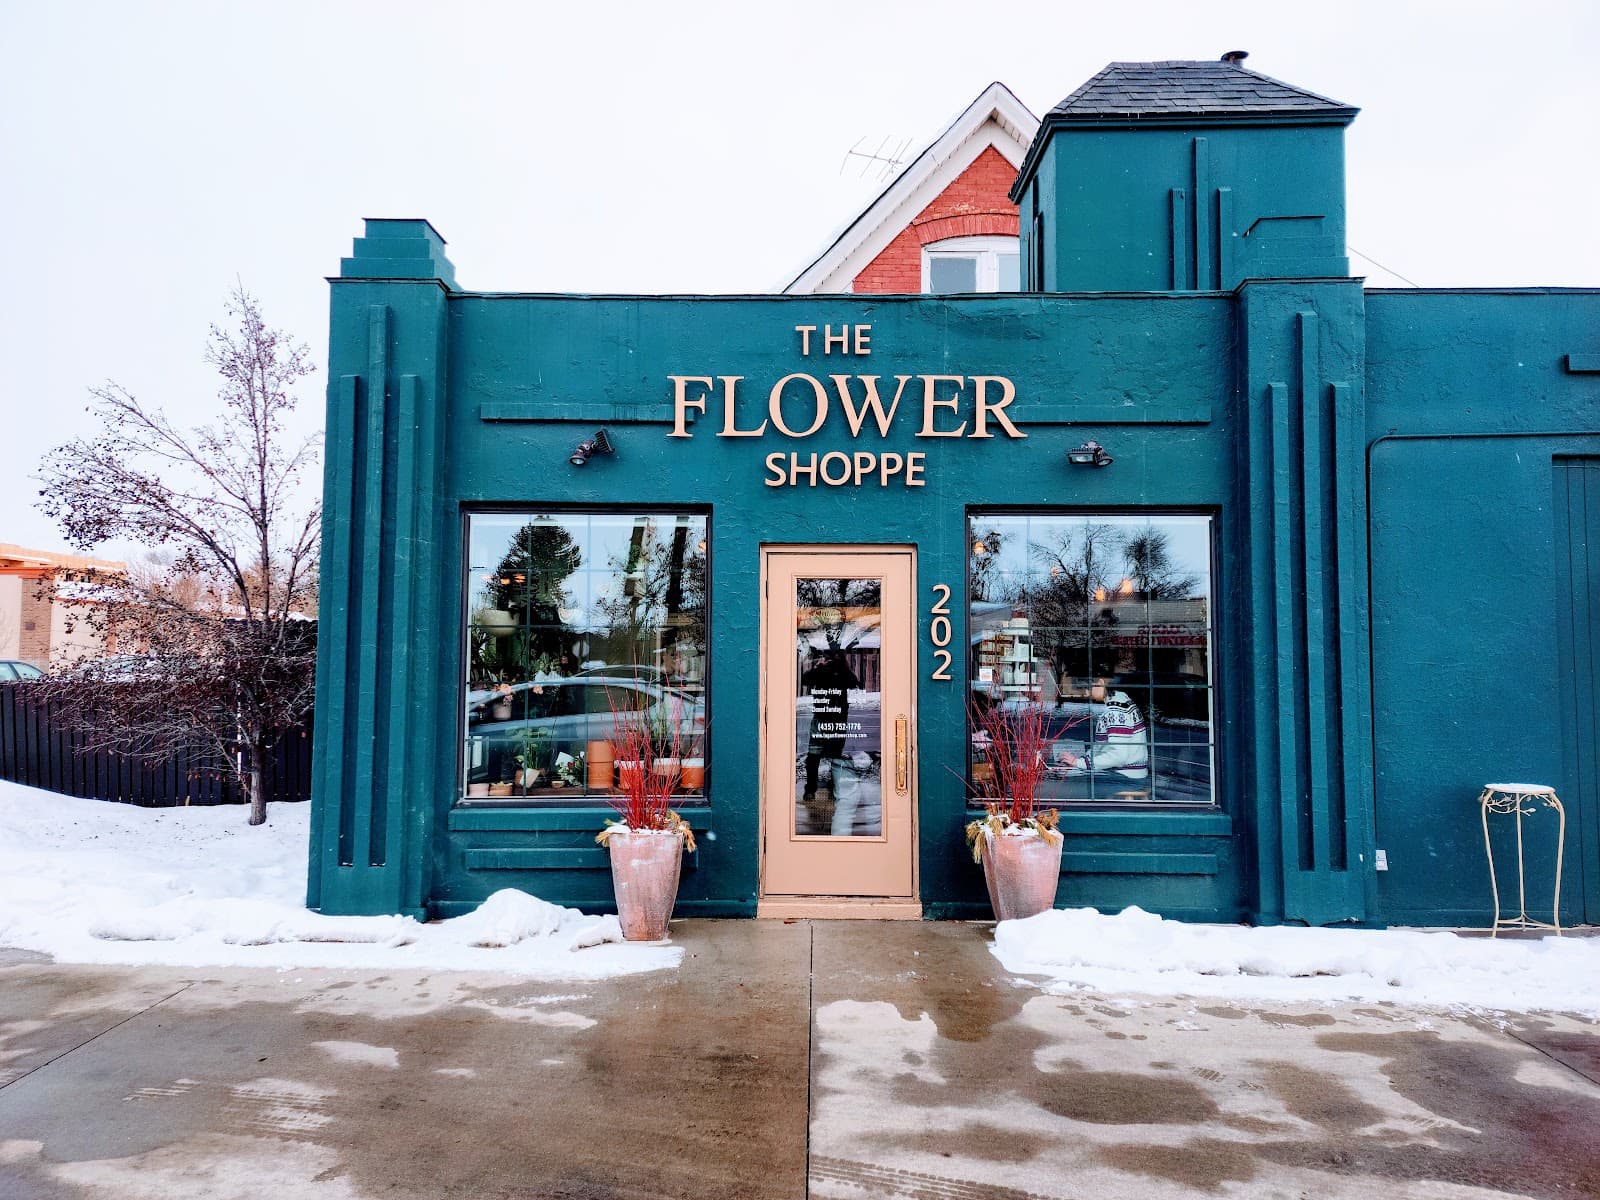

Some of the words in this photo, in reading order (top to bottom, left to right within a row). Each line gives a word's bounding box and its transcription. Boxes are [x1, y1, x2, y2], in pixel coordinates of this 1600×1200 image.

[795, 324, 872, 356] THE
[666, 373, 1028, 438] FLOWER
[765, 452, 926, 488] SHOPPE
[931, 584, 952, 681] 202
[817, 723, 834, 731] (435)
